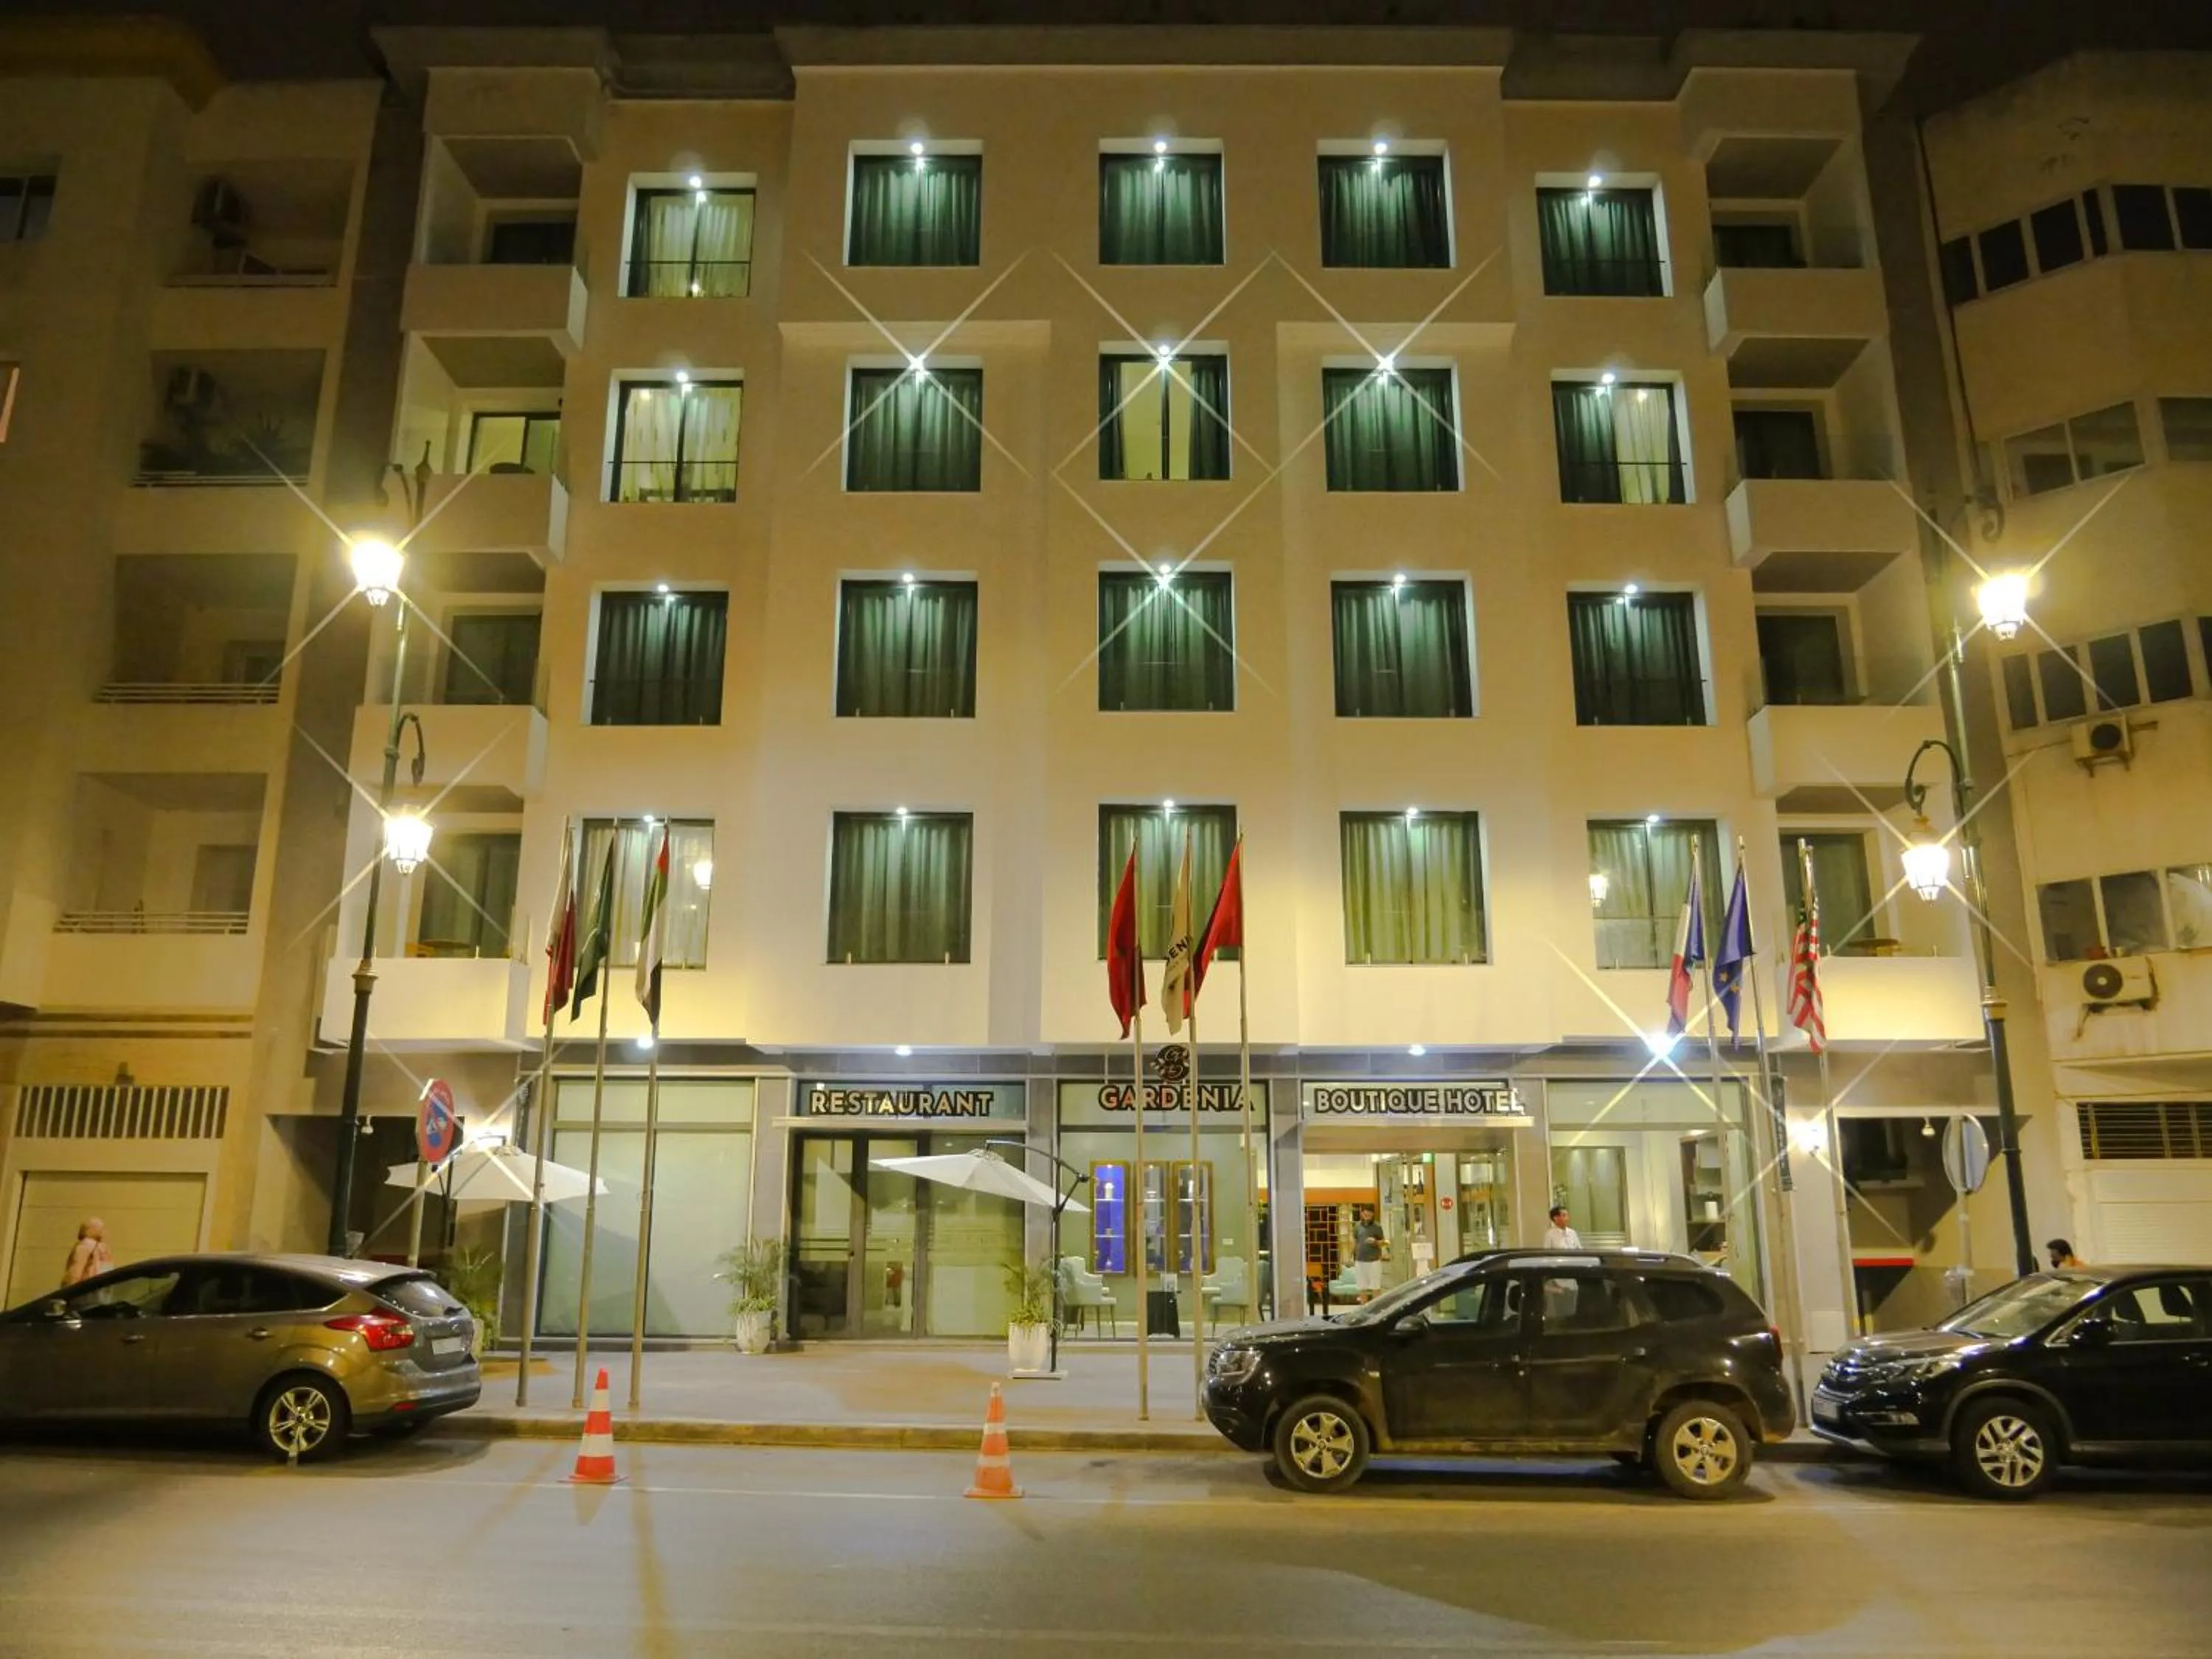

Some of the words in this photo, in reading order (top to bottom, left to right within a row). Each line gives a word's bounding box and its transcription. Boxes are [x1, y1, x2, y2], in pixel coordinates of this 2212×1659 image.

[810, 1090, 994, 1116] RESTAURANT
[1099, 1085, 1255, 1111] GARDENIA
[1315, 1088, 1440, 1114] BOUTIQUE
[1444, 1088, 1525, 1115] HOTEL
